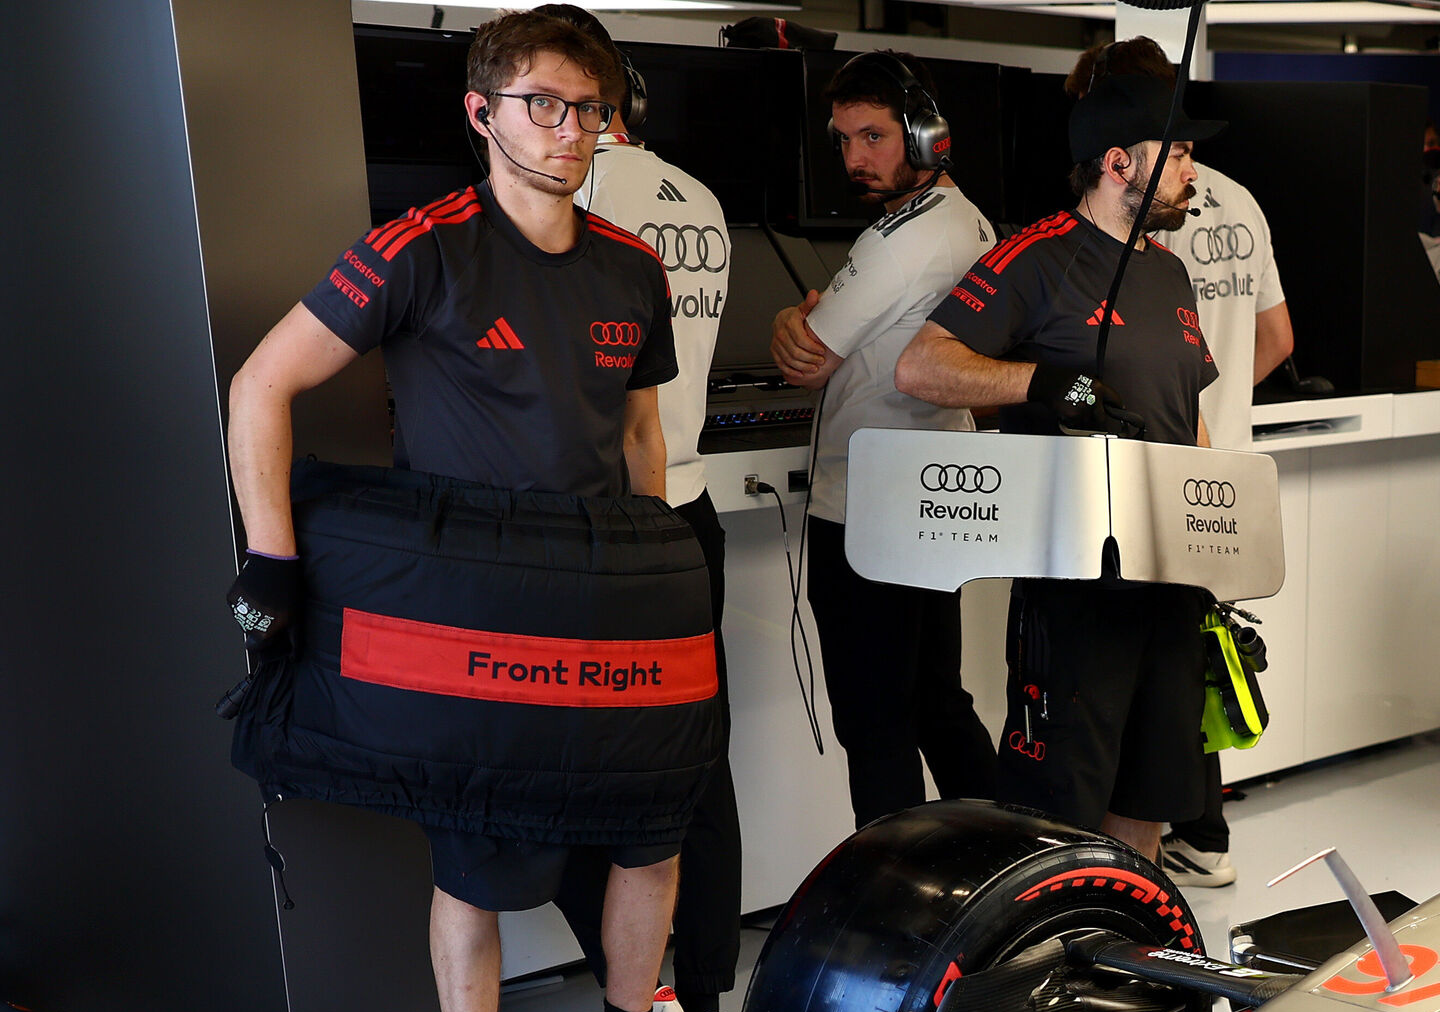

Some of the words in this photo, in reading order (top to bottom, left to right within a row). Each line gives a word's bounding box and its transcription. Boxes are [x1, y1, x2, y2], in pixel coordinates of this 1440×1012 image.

[347, 254, 386, 288] Castrol
[329, 268, 370, 309] PIRELLI
[671, 287, 723, 318] volut
[919, 499, 999, 522] Revolut
[1186, 513, 1238, 535] Revolut
[951, 532, 999, 543] TEAM
[1209, 545, 1240, 555] TEAM
[467, 651, 568, 687] Front
[579, 660, 663, 692] Right
[1147, 950, 1224, 971] Extreme
